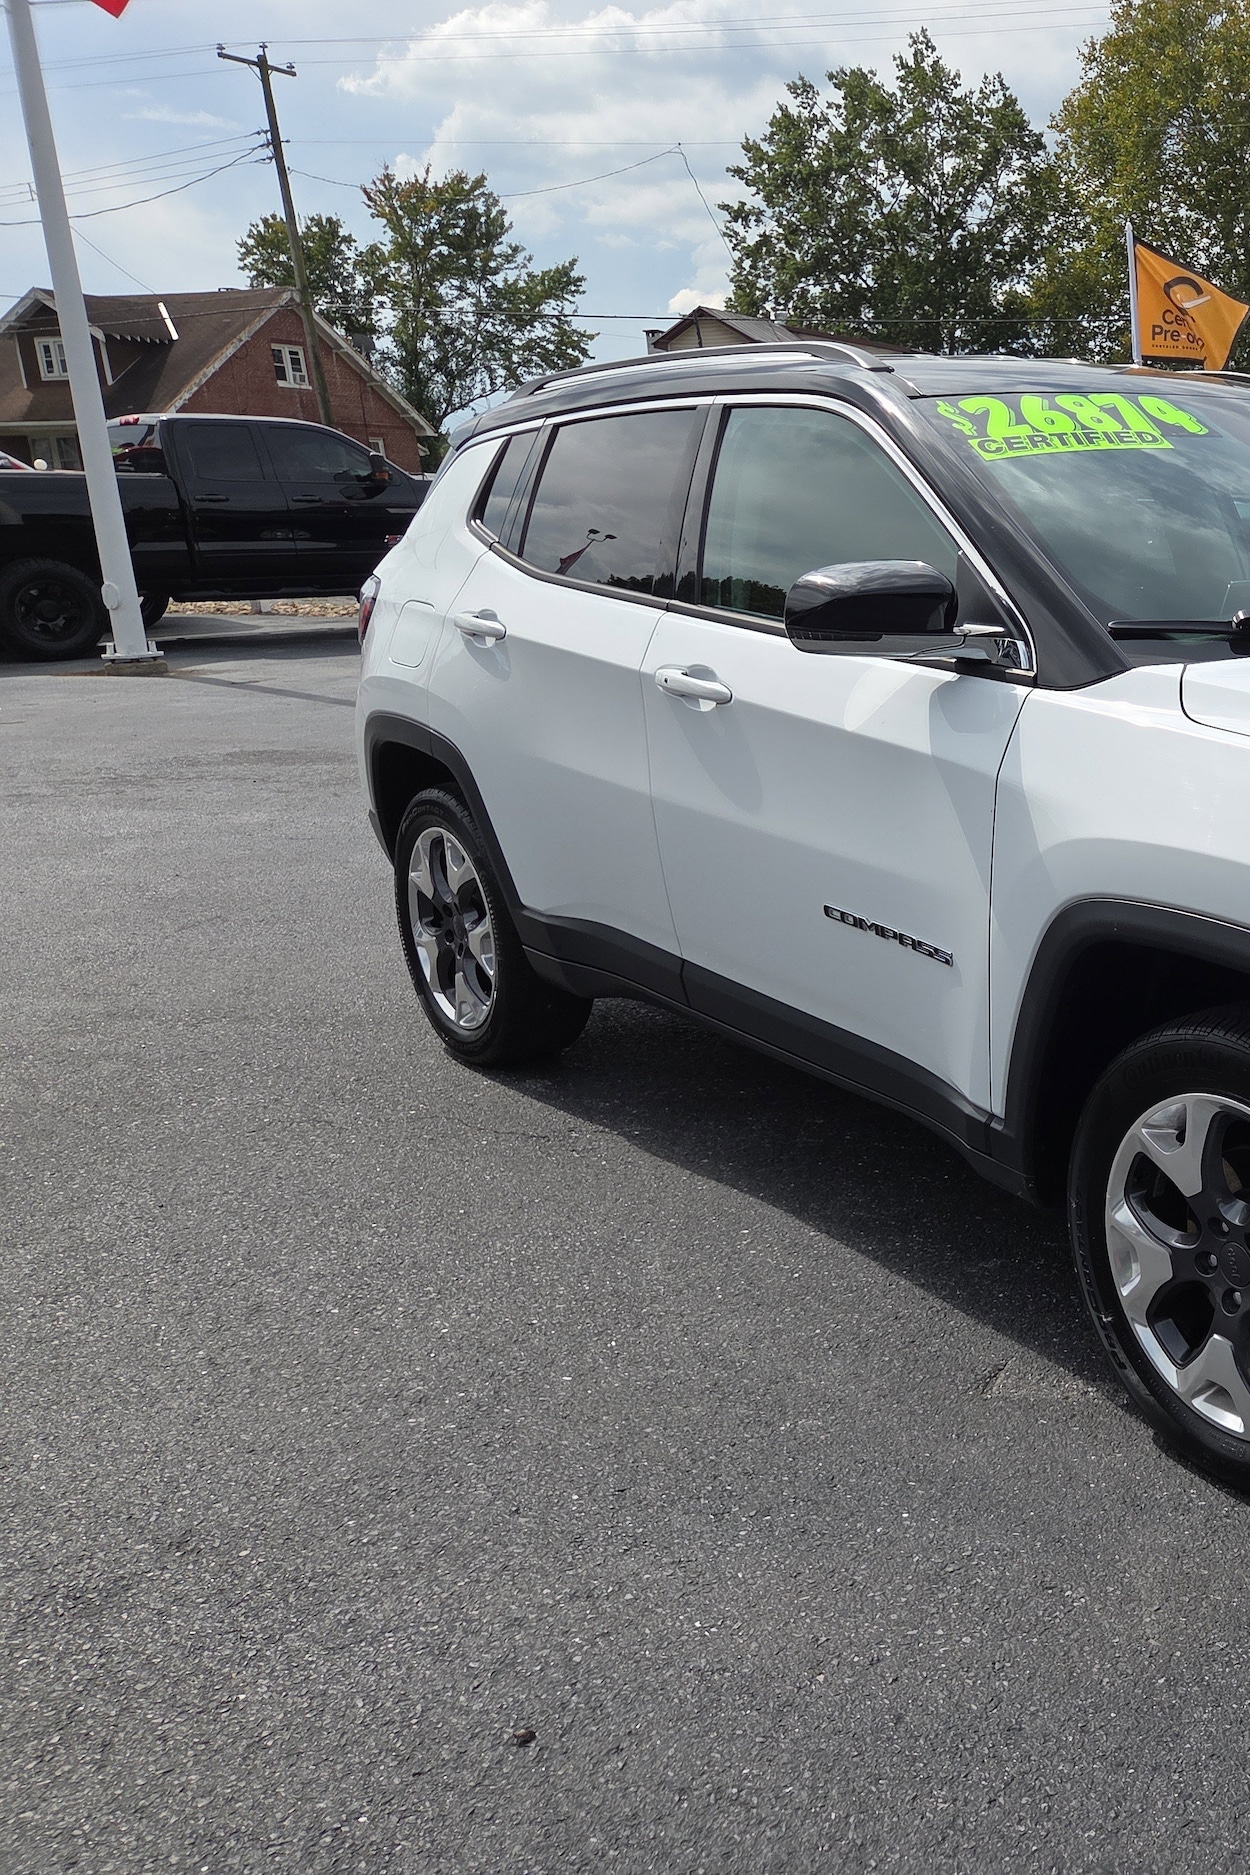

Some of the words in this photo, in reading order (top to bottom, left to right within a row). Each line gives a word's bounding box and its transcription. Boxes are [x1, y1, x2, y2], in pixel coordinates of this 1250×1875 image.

[935, 393, 1210, 438] $26874
[977, 430, 1163, 455] CERTIFIED
[822, 903, 954, 967] COMPASS
